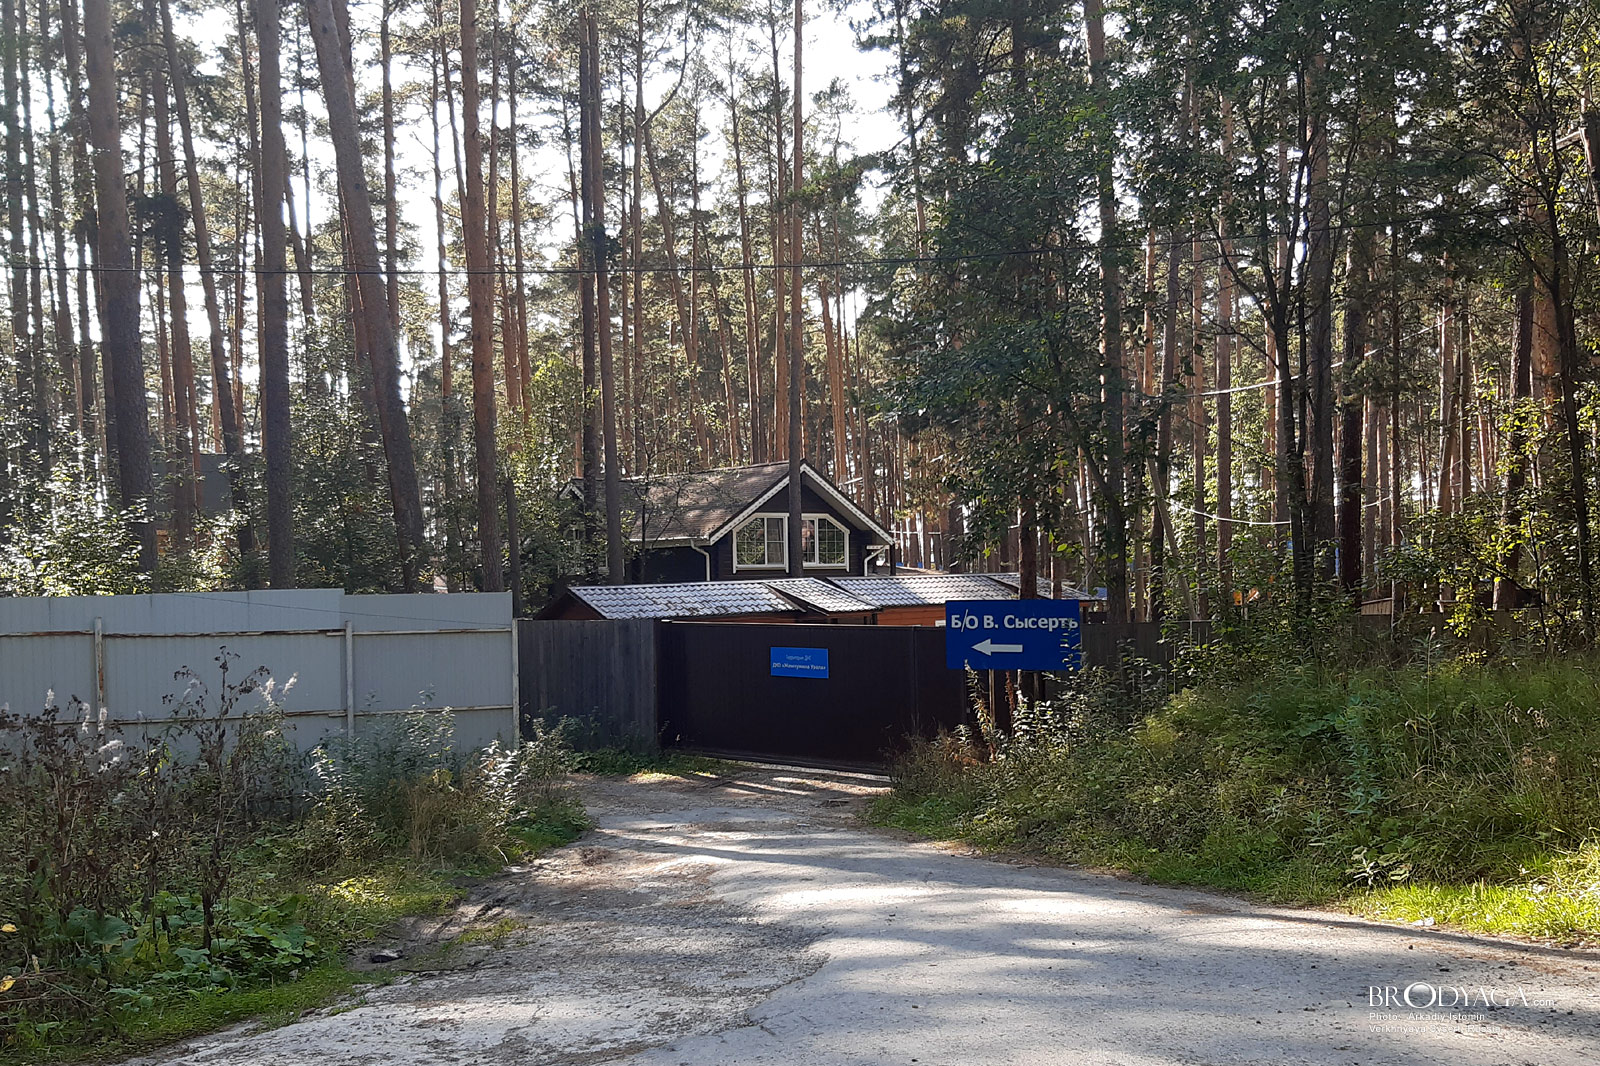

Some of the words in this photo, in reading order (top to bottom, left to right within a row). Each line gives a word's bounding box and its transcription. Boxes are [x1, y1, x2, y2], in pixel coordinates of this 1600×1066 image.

[951, 609, 979, 632] Б/О
[983, 615, 999, 629] В.
[1003, 615, 1079, 632] Сысерть
